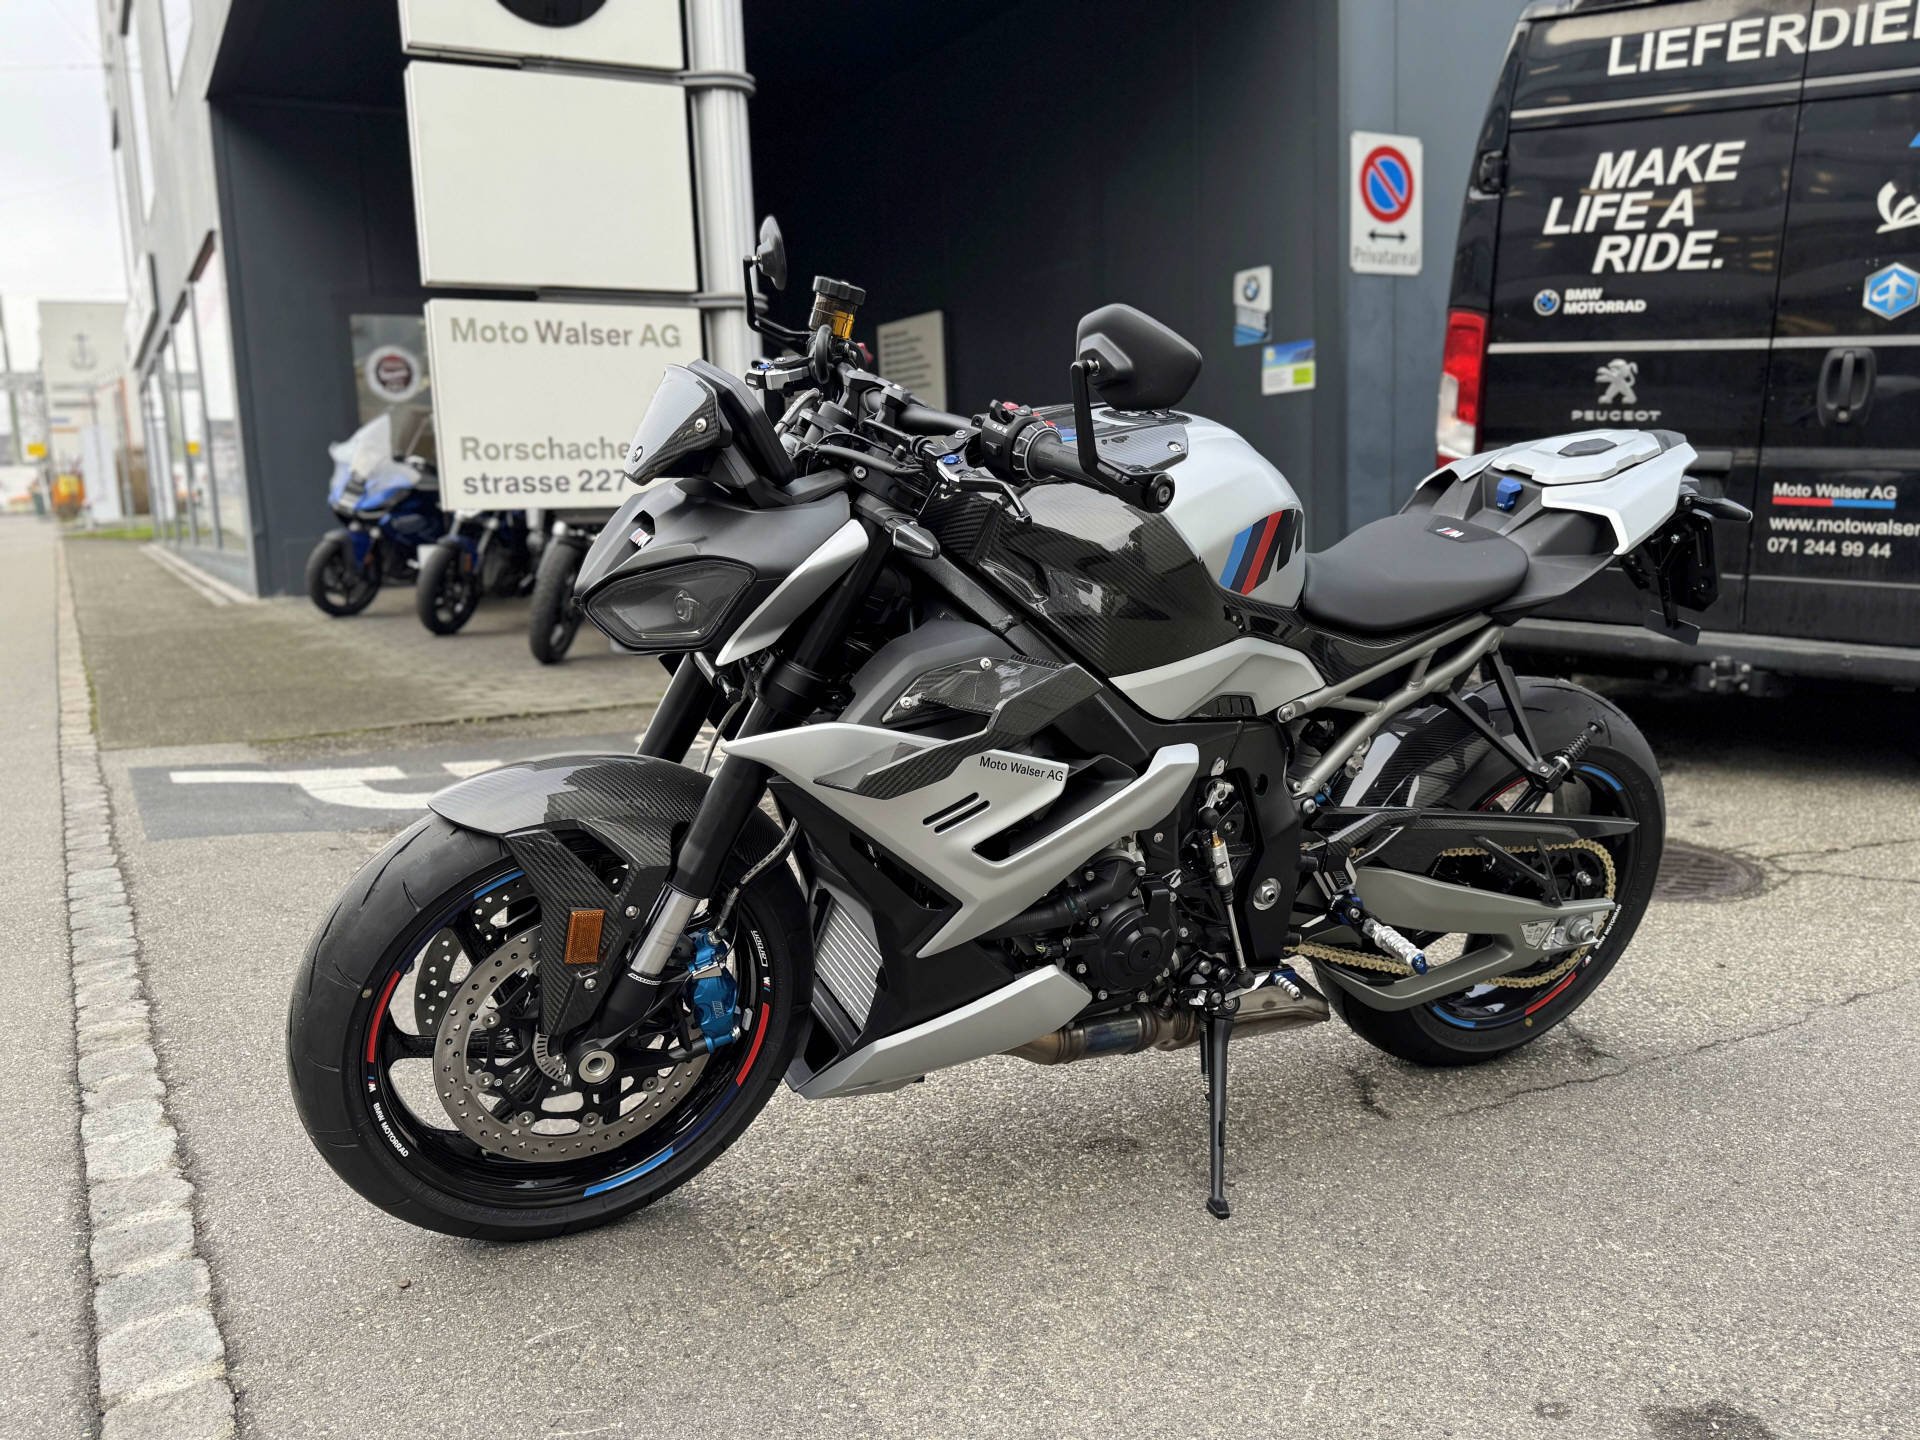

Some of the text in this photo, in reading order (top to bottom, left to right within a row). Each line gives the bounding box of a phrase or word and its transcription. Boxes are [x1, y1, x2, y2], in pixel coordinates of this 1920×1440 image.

[1607, 0, 1920, 77] LIEFERDIE
[1590, 140, 1746, 190] MAKE
[1542, 188, 1694, 236] LIFE A
[1591, 229, 1725, 274] RIDE.
[1562, 299, 1647, 315] MOTORRAD
[1564, 287, 1603, 301] BMW
[450, 317, 682, 348] Moto Walser AG
[1571, 409, 1662, 422] PEUGEOT
[463, 469, 627, 495] strasse 227
[1773, 482, 1898, 500] Moto Walser AG
[1767, 536, 1892, 558] 071 244 99 44
[980, 756, 1064, 782] Moto Walser AG
[1604, 904, 1622, 936] MOTORRAD
[750, 930, 769, 967] Carbon
[373, 1102, 409, 1157] BMW MOTORRAD
